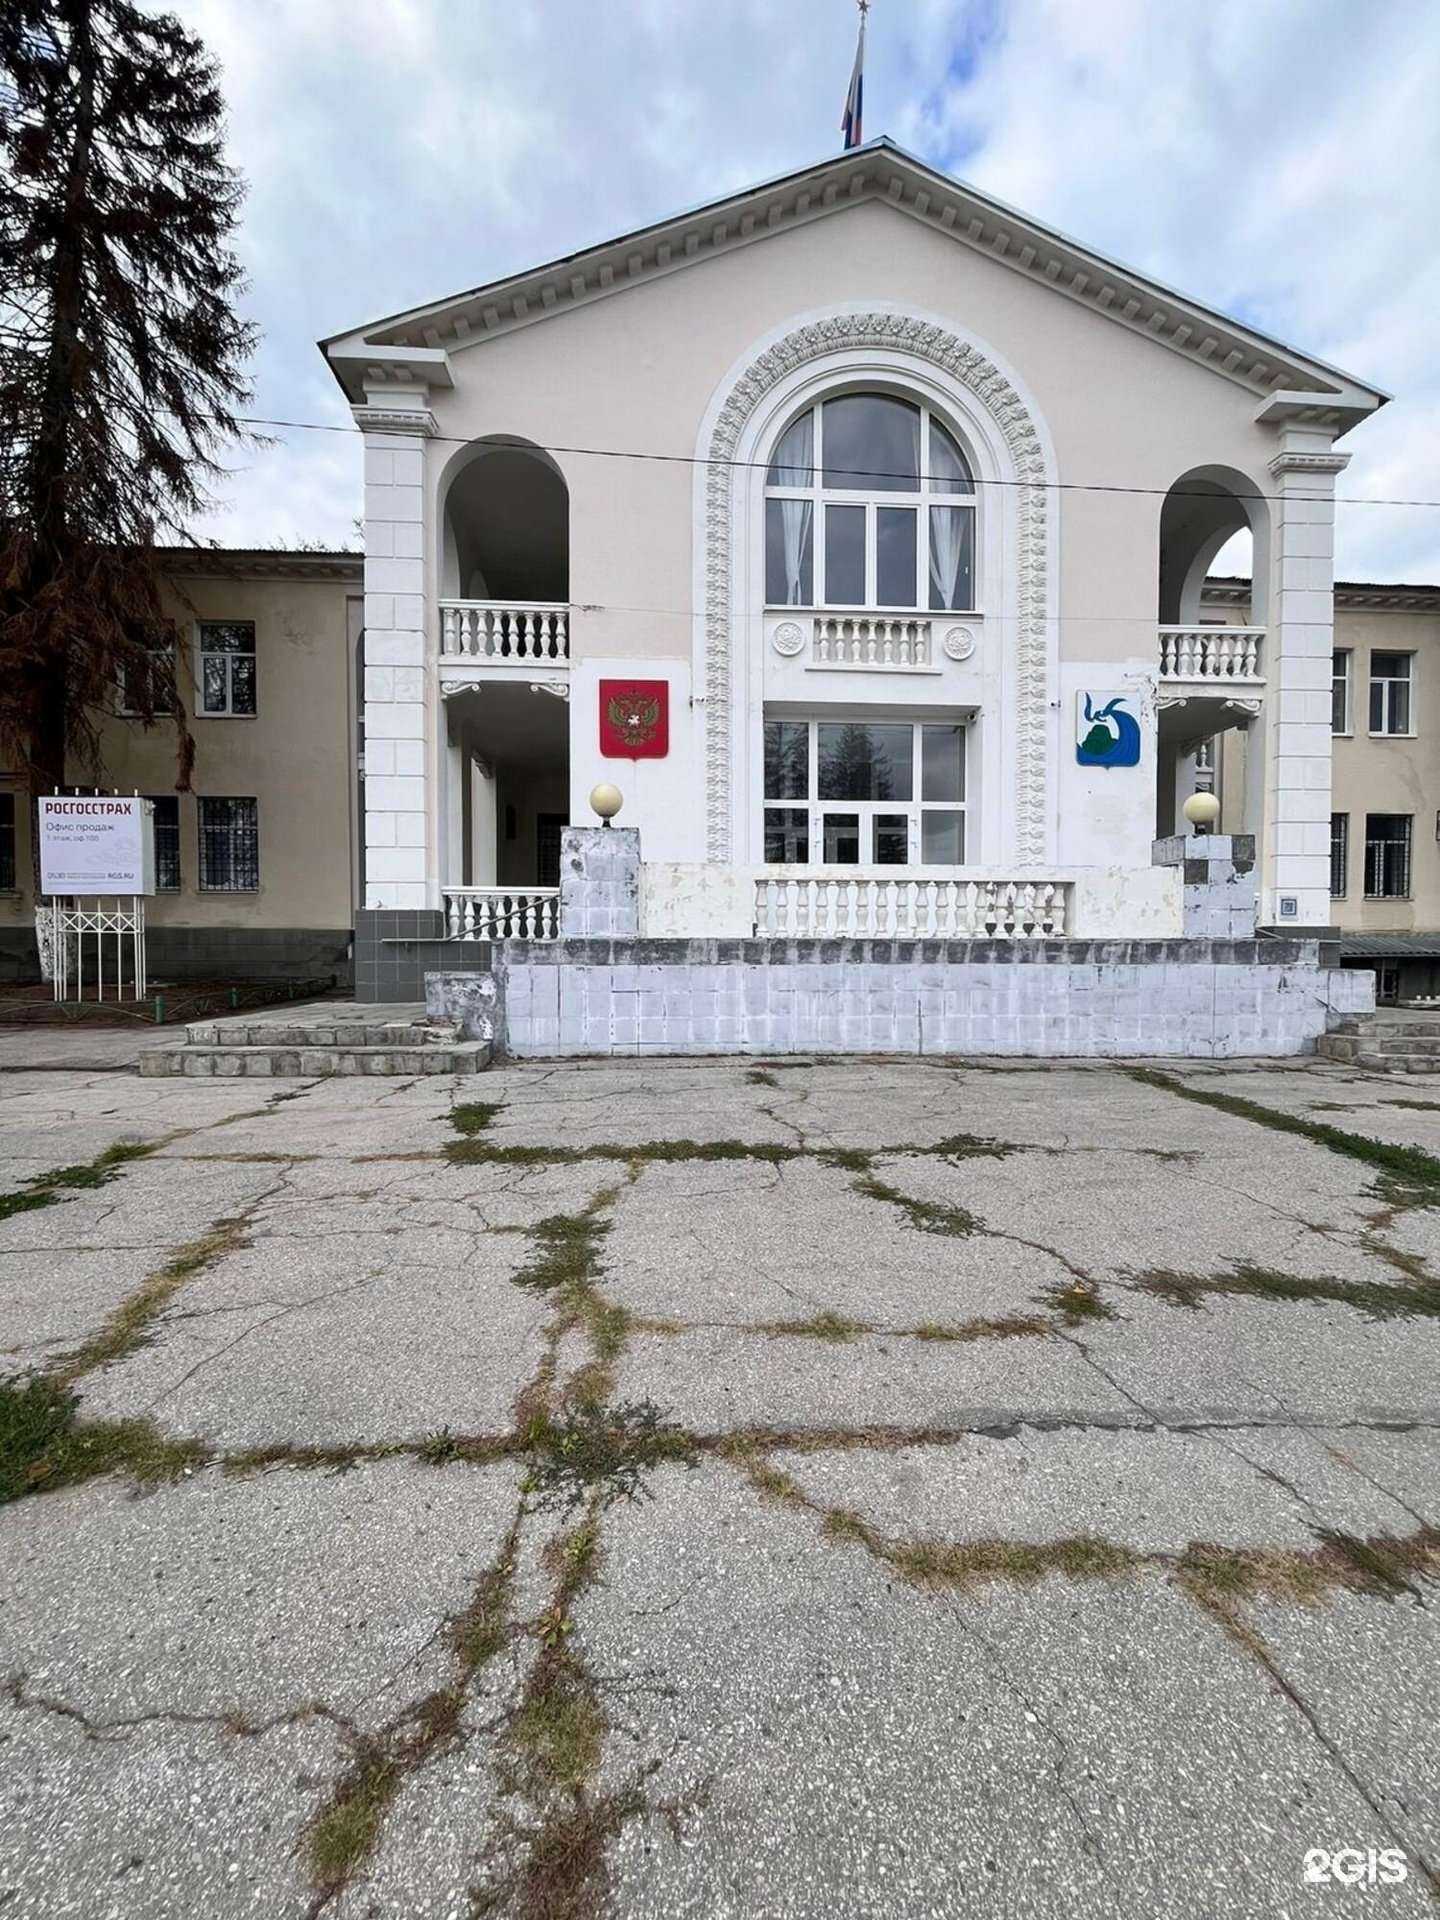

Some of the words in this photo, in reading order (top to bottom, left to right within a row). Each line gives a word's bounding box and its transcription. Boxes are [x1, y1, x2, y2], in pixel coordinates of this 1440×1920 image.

[45, 802, 132, 815] РОСГОССТРАХ
[46, 822, 74, 832] Офис
[75, 823, 114, 832] продаж
